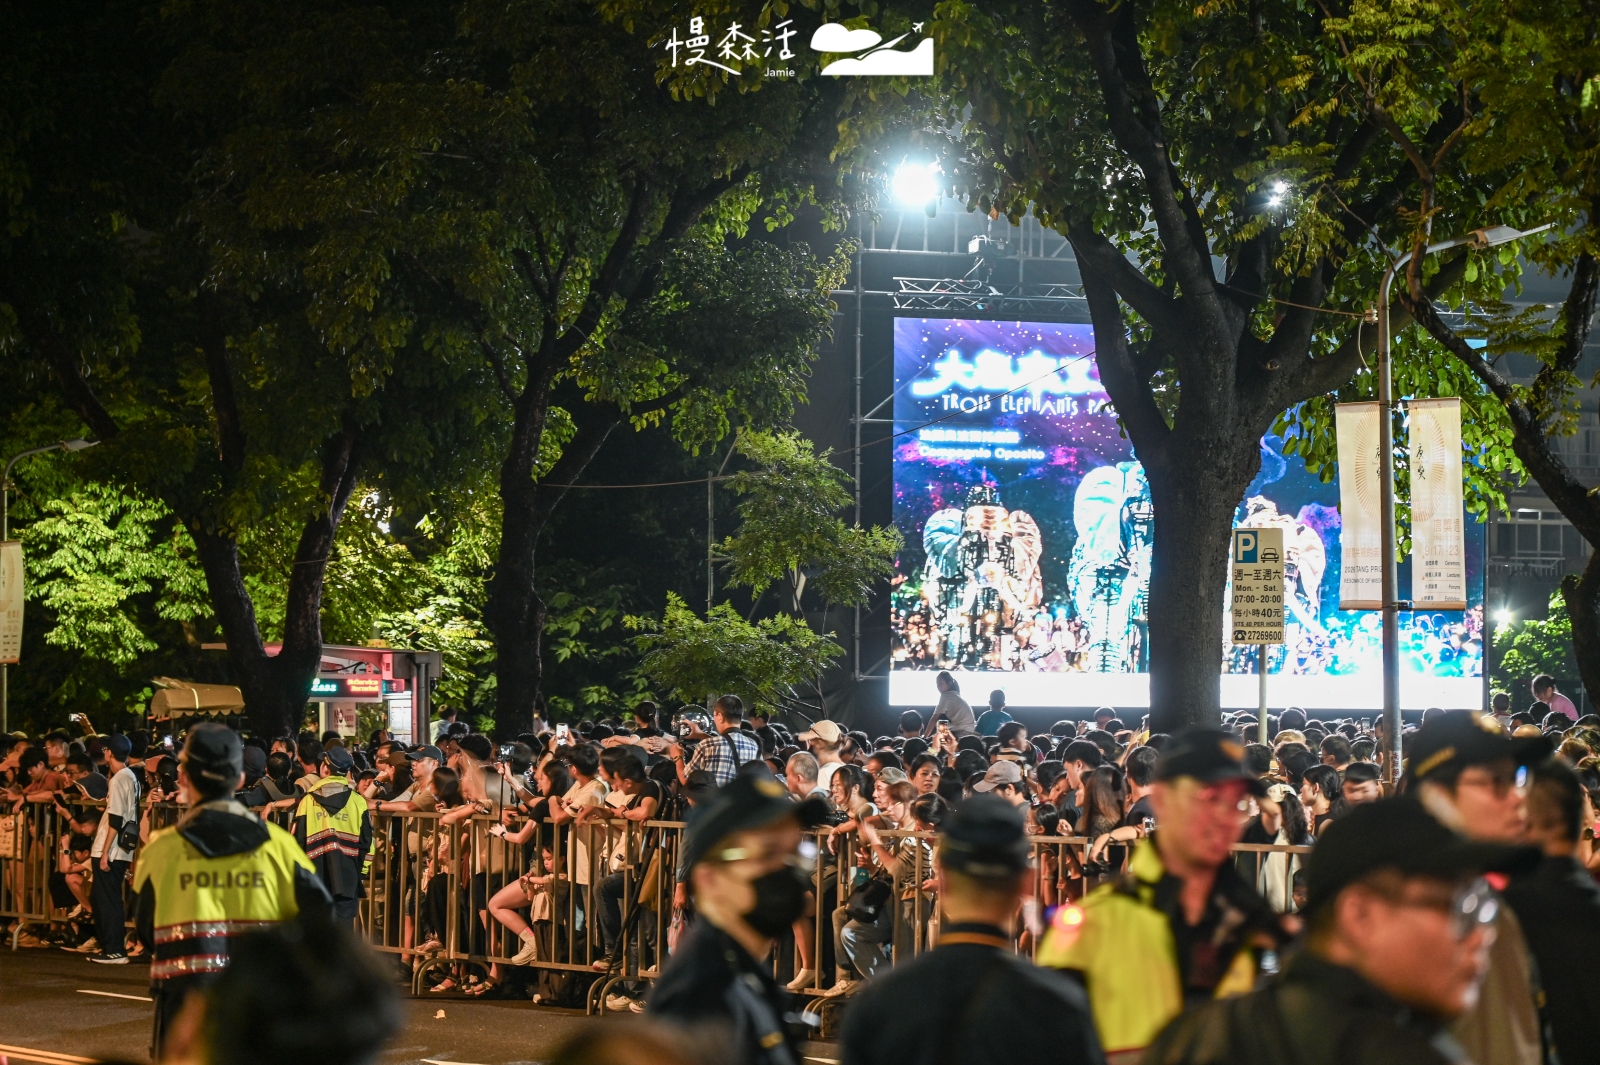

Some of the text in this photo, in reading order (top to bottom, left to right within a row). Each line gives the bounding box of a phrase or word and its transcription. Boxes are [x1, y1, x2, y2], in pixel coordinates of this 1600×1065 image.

[941, 394, 991, 414] TROIS
[1237, 533, 1256, 561] P
[1234, 569, 1282, 581] 週一至週六
[1235, 584, 1253, 592] Mon.
[1263, 584, 1278, 592] Sat.
[1234, 608, 1282, 618] 每小時40元
[1247, 630, 1282, 641] 27269600
[180, 870, 265, 891] POLICE
